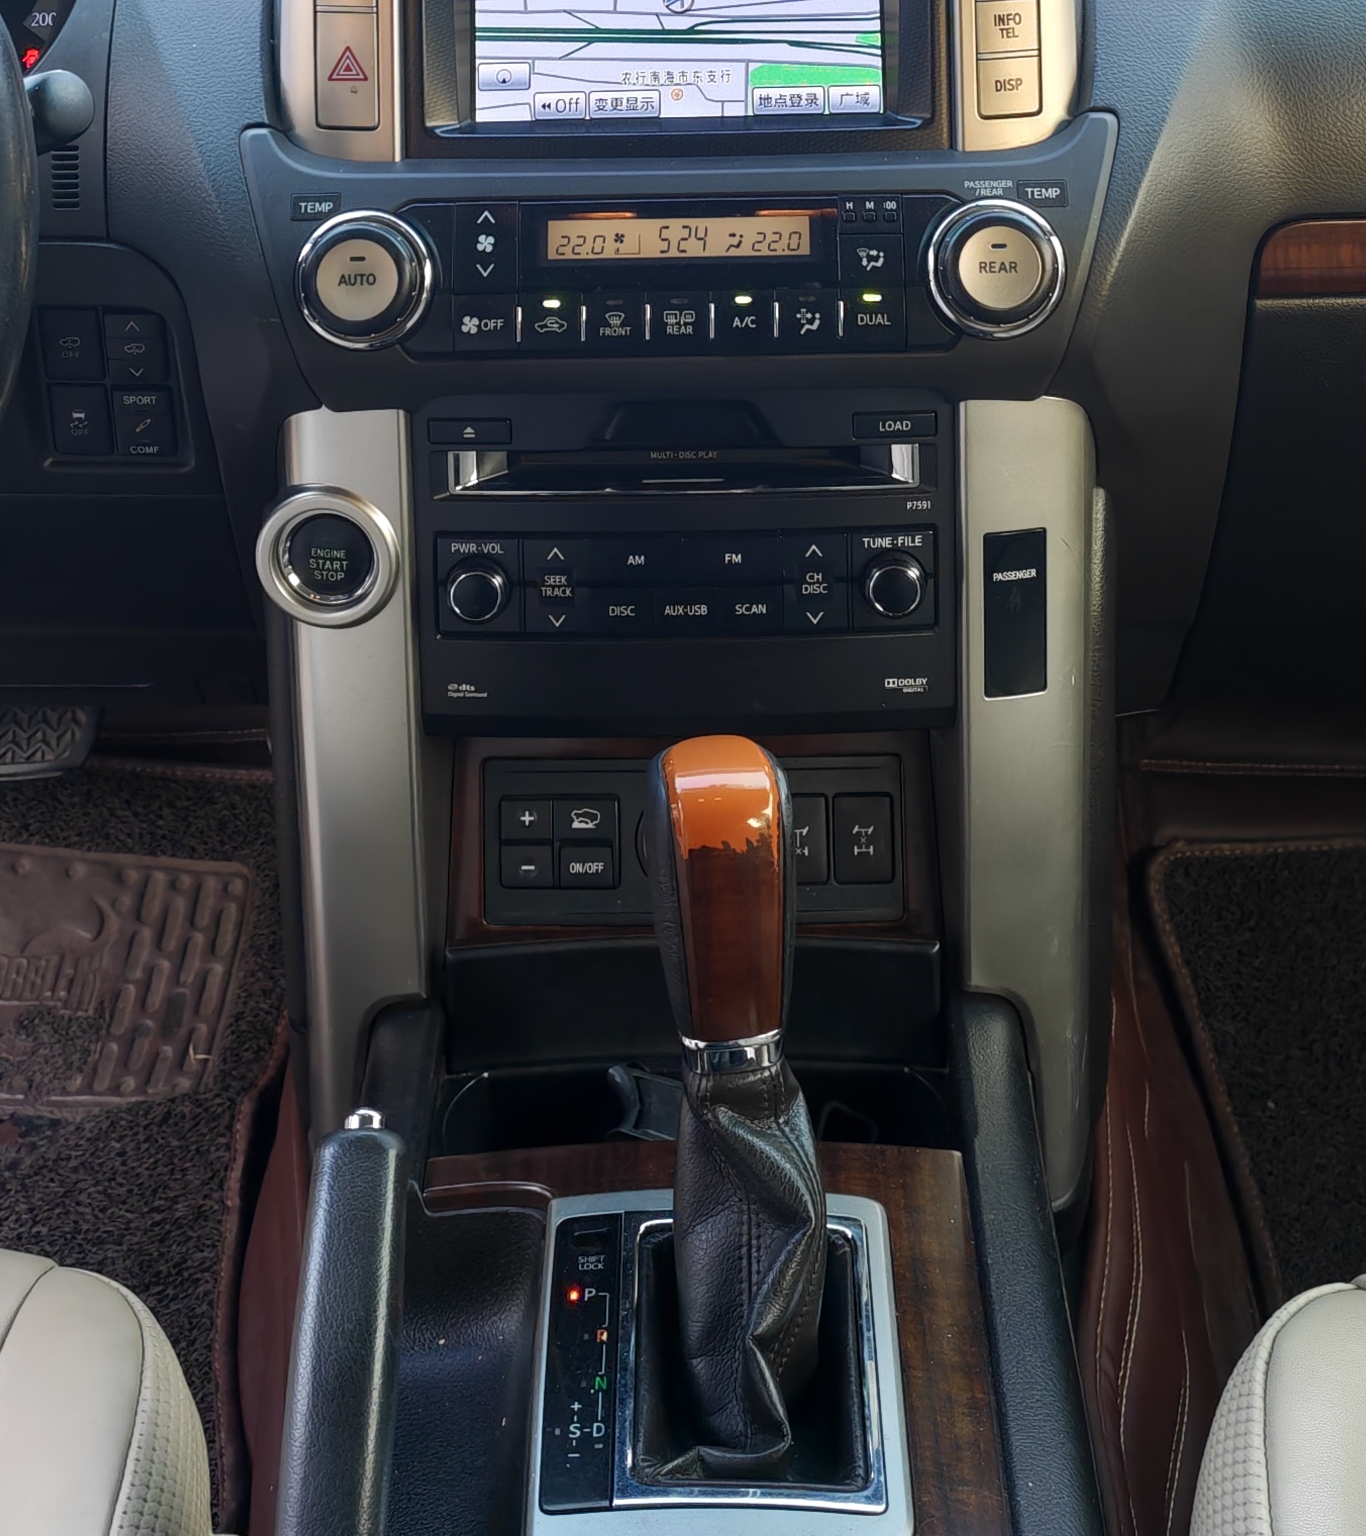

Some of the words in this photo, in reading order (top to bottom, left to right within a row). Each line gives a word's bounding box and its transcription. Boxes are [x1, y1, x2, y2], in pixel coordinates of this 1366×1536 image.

[993, 12, 1022, 27] INFO
[998, 27, 1020, 40] TEL
[621, 69, 732, 85] 农行南海市东支行
[994, 78, 1023, 93] DISP
[555, 96, 581, 114] Off
[593, 96, 655, 112] 变更显示
[757, 92, 821, 108] 地点登录
[838, 91, 871, 107] 广域
[964, 180, 1013, 189] PASSENGER
[1025, 187, 1061, 199] TEMP
[298, 202, 334, 213] TEMP
[846, 202, 854, 210] H
[865, 201, 875, 210] M
[555, 235, 606, 256] 22.0
[751, 231, 802, 252] 22.0
[978, 261, 1018, 274] REAR
[338, 273, 377, 287] AUTO
[481, 319, 505, 331] OFF
[733, 316, 757, 328] A/C
[857, 314, 892, 326] DUAL
[599, 326, 632, 337] FRONT
[666, 325, 694, 336] REAR
[123, 396, 157, 405] SPORT
[879, 420, 912, 432] LOAD
[130, 445, 160, 454] COMF
[698, 450, 718, 459] PLAY
[906, 500, 932, 511] P7591
[311, 547, 346, 559] ENGINE
[725, 553, 742, 563] FM
[309, 558, 349, 571] START
[627, 555, 645, 566] AM
[314, 570, 345, 581] STOP
[544, 575, 567, 586] SEEK
[806, 572, 822, 583] CH
[993, 568, 1037, 582] PASSENGER
[541, 587, 572, 597] TRACK
[802, 583, 828, 594] DISC
[609, 605, 636, 616] DISC
[735, 603, 767, 615] SCAN
[459, 683, 475, 692] dts
[898, 677, 928, 686] DOLBY
[569, 861, 605, 876] ON/OFF
[578, 1255, 606, 1264] SHIFT
[578, 1263, 605, 1271] LOCK
[585, 1288, 596, 1302] P
[596, 1329, 608, 1343] R
[595, 1376, 607, 1390] N
[569, 1423, 581, 1438] S
[592, 1423, 605, 1438] D
